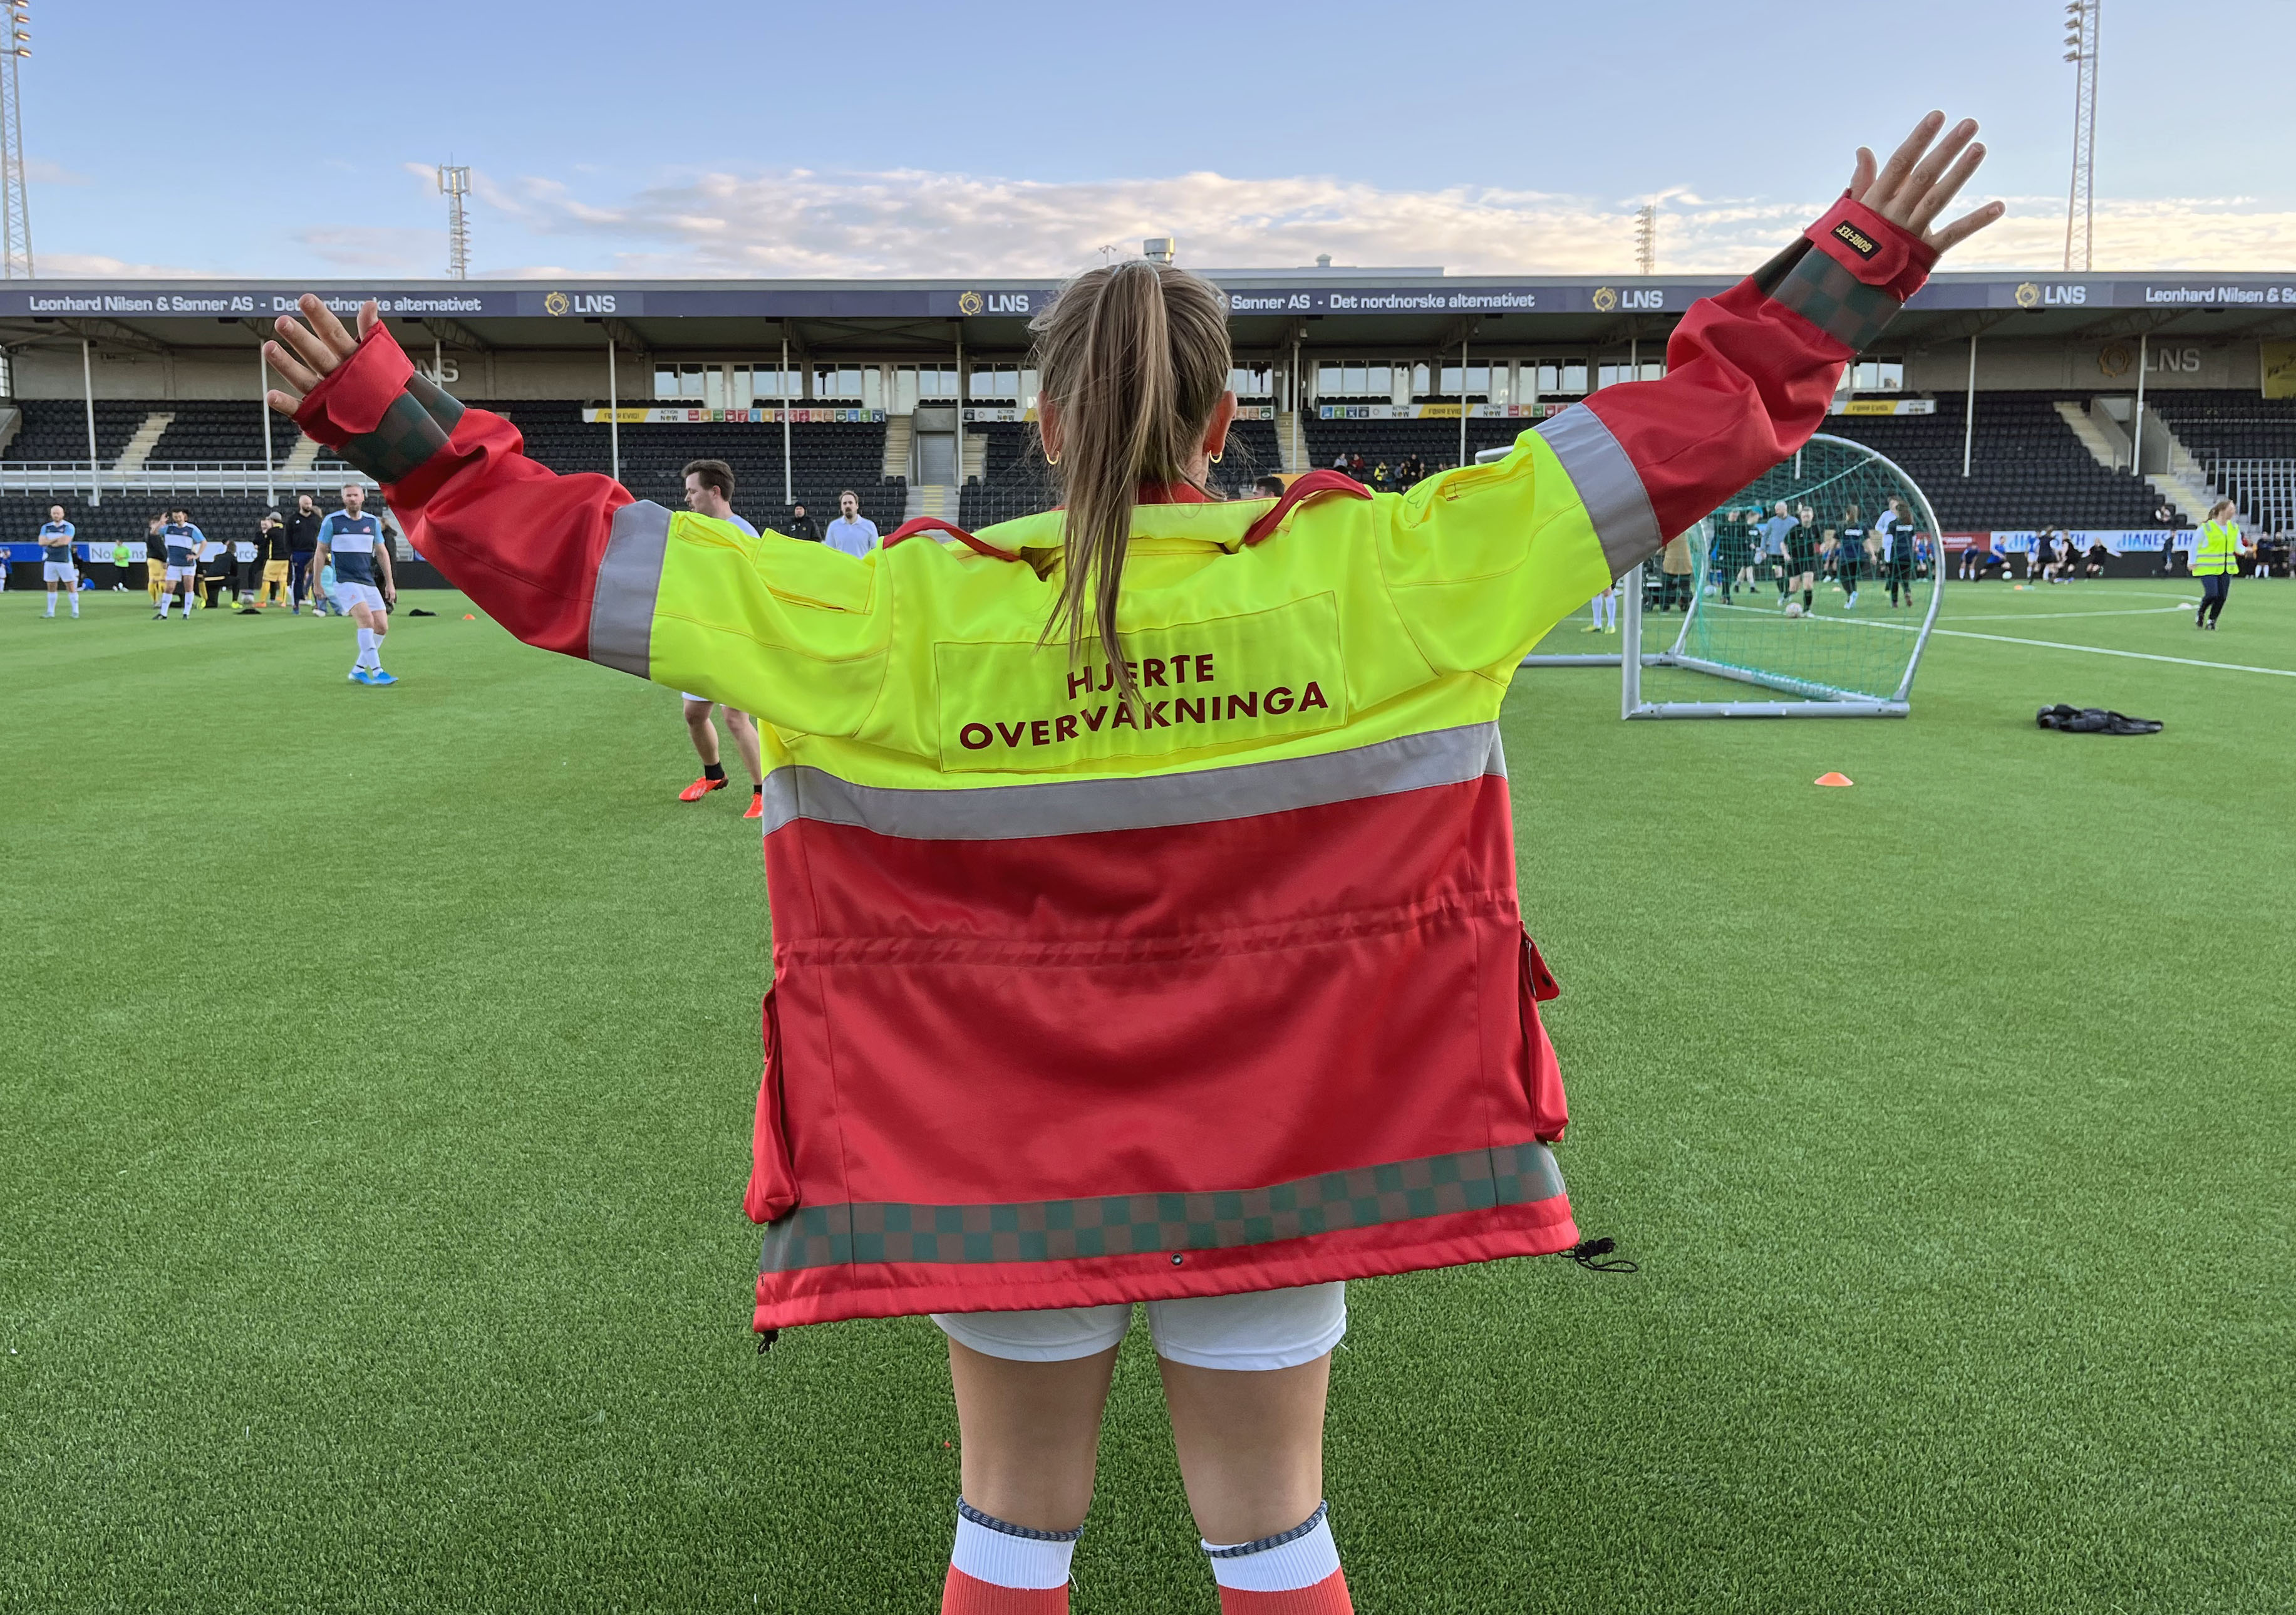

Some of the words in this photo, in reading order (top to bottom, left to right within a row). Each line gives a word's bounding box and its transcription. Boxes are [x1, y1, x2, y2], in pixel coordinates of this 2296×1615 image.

[29, 295, 101, 311] Leonhard
[105, 296, 153, 311] Nilsen
[156, 296, 170, 311] &
[172, 296, 227, 311] Sønner
[230, 296, 253, 311] AS
[273, 296, 301, 312] Det
[394, 296, 482, 312] alternativet
[988, 294, 1029, 312] LNS
[1231, 294, 1285, 309] Sønner
[1288, 294, 1310, 309] AS
[1330, 294, 1358, 309] Det
[1360, 293, 1445, 309] nordnorske
[1449, 292, 1535, 308] alternativet
[1621, 290, 1663, 308] LNS
[2044, 285, 2086, 304] LNS
[2145, 286, 2215, 303] Leonhard
[2218, 287, 2263, 303] Nilsen
[2266, 287, 2280, 303] &
[574, 295, 616, 313] LNS
[2144, 348, 2200, 371] LNS
[416, 358, 459, 383] NS
[1067, 653, 1214, 700] HJERTE
[959, 680, 1328, 750] OVERVÅKNINGA
